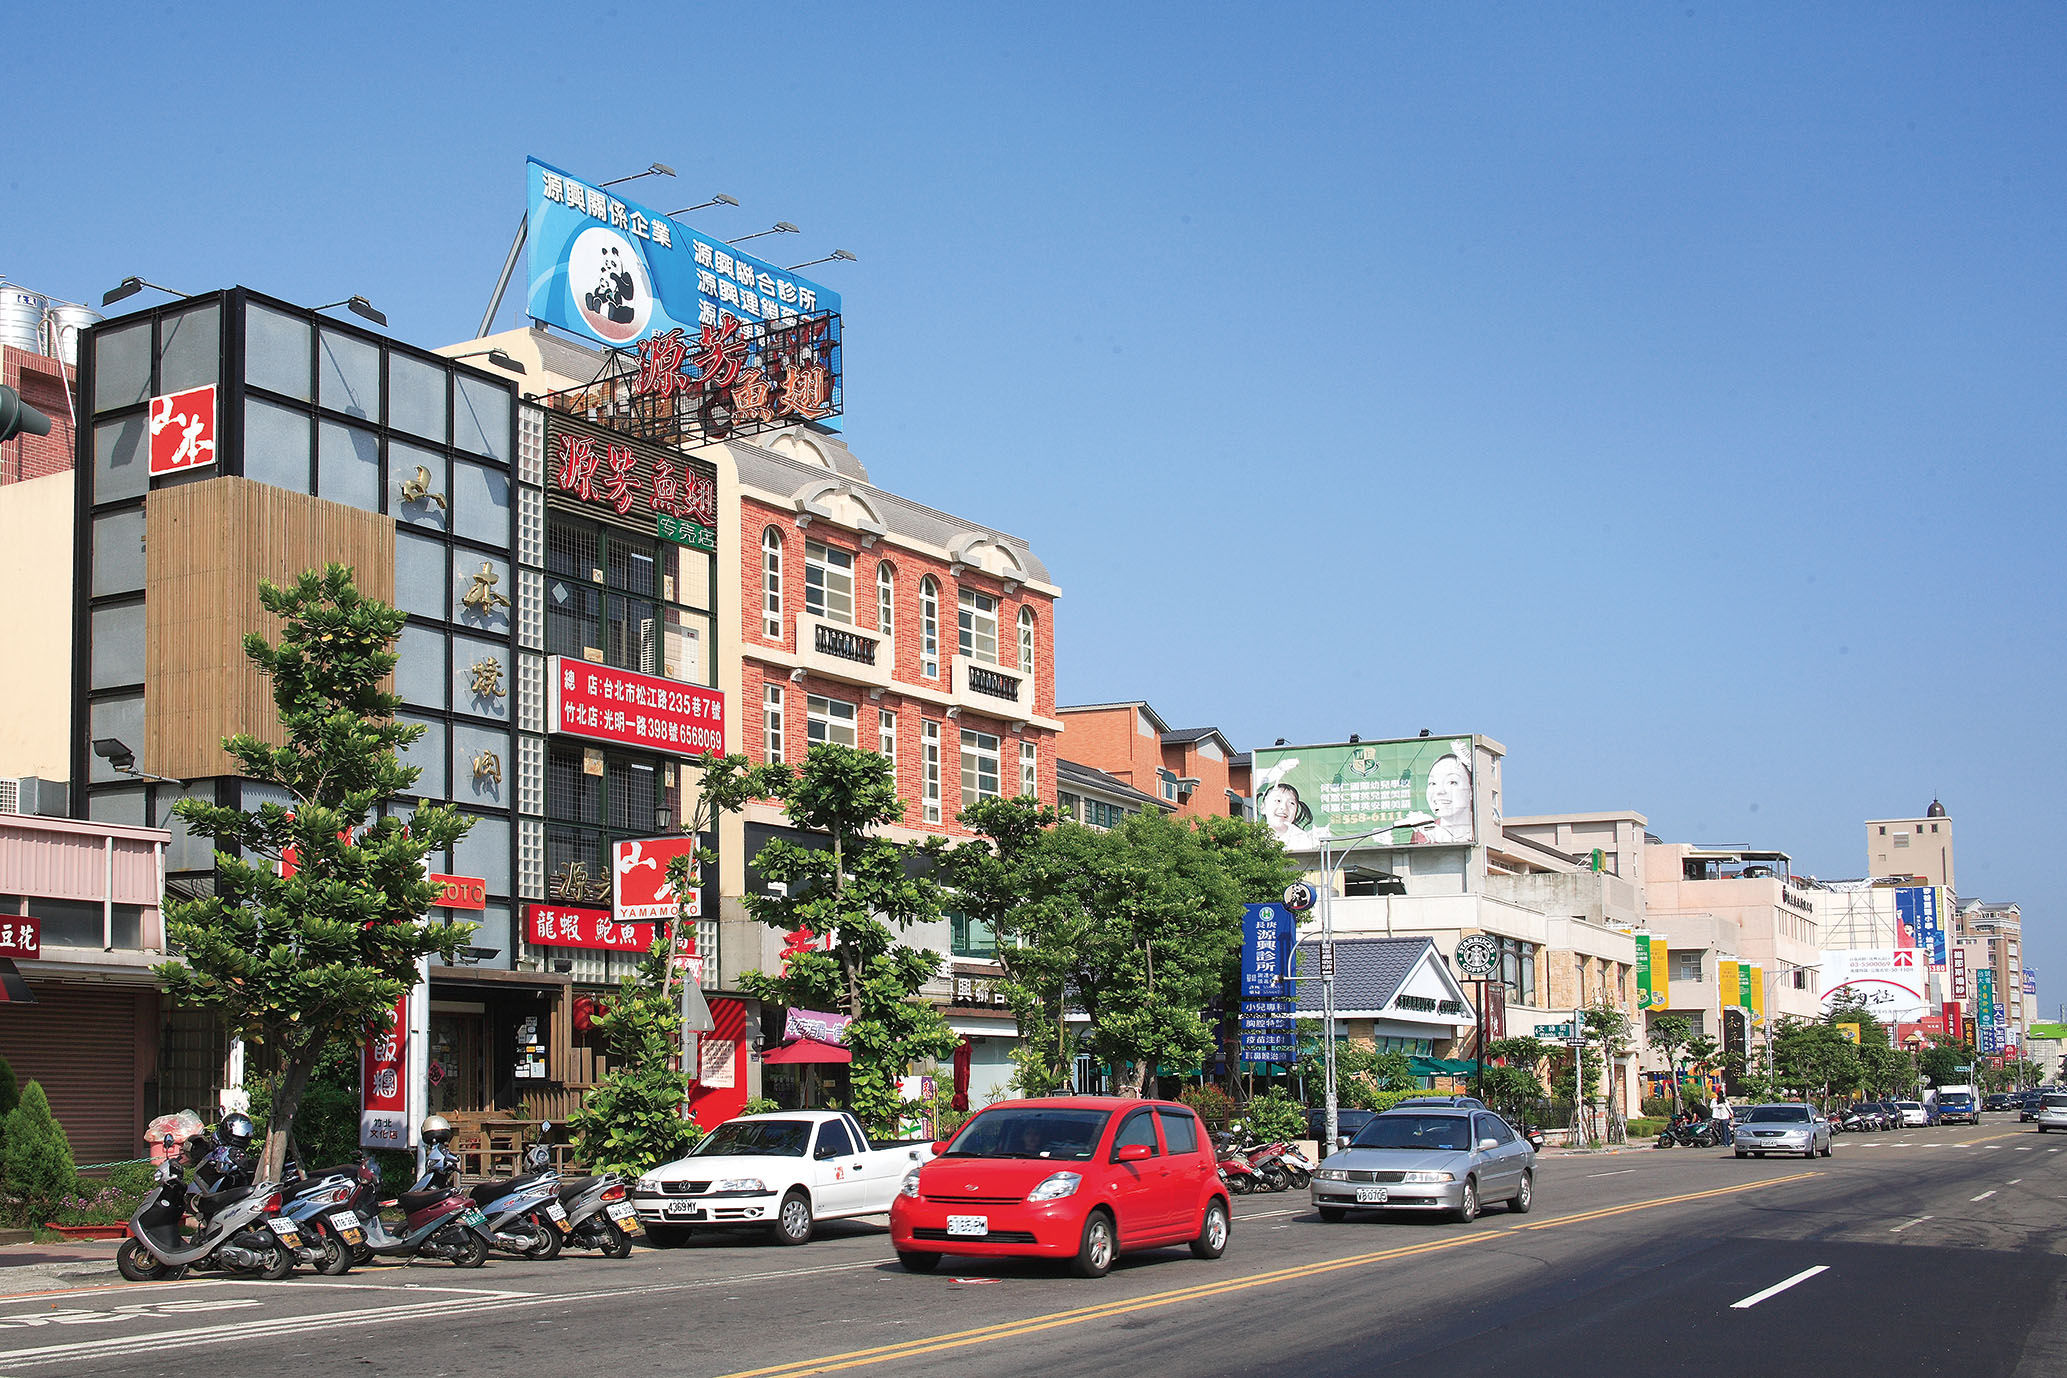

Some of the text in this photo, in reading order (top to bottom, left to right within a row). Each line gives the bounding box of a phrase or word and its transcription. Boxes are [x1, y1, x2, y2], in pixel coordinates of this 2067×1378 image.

[542, 170, 673, 249] 源興關係企業
[692, 239, 817, 312] 源興聯合診所
[696, 267, 813, 327] 源興連鎖藥
[557, 433, 718, 527] 源芳魚翅
[680, 723, 722, 750] 6568069
[620, 905, 698, 918] YAMAMOO
[0, 923, 37, 951] 豆花
[536, 910, 582, 942] 龍蝦
[595, 916, 638, 946] 鮑魚
[1457, 937, 1497, 955] STARBUCKS
[1462, 963, 1492, 973] COFFEE
[369, 1129, 398, 1140] 文化店
[373, 1118, 393, 1128] 竹北
